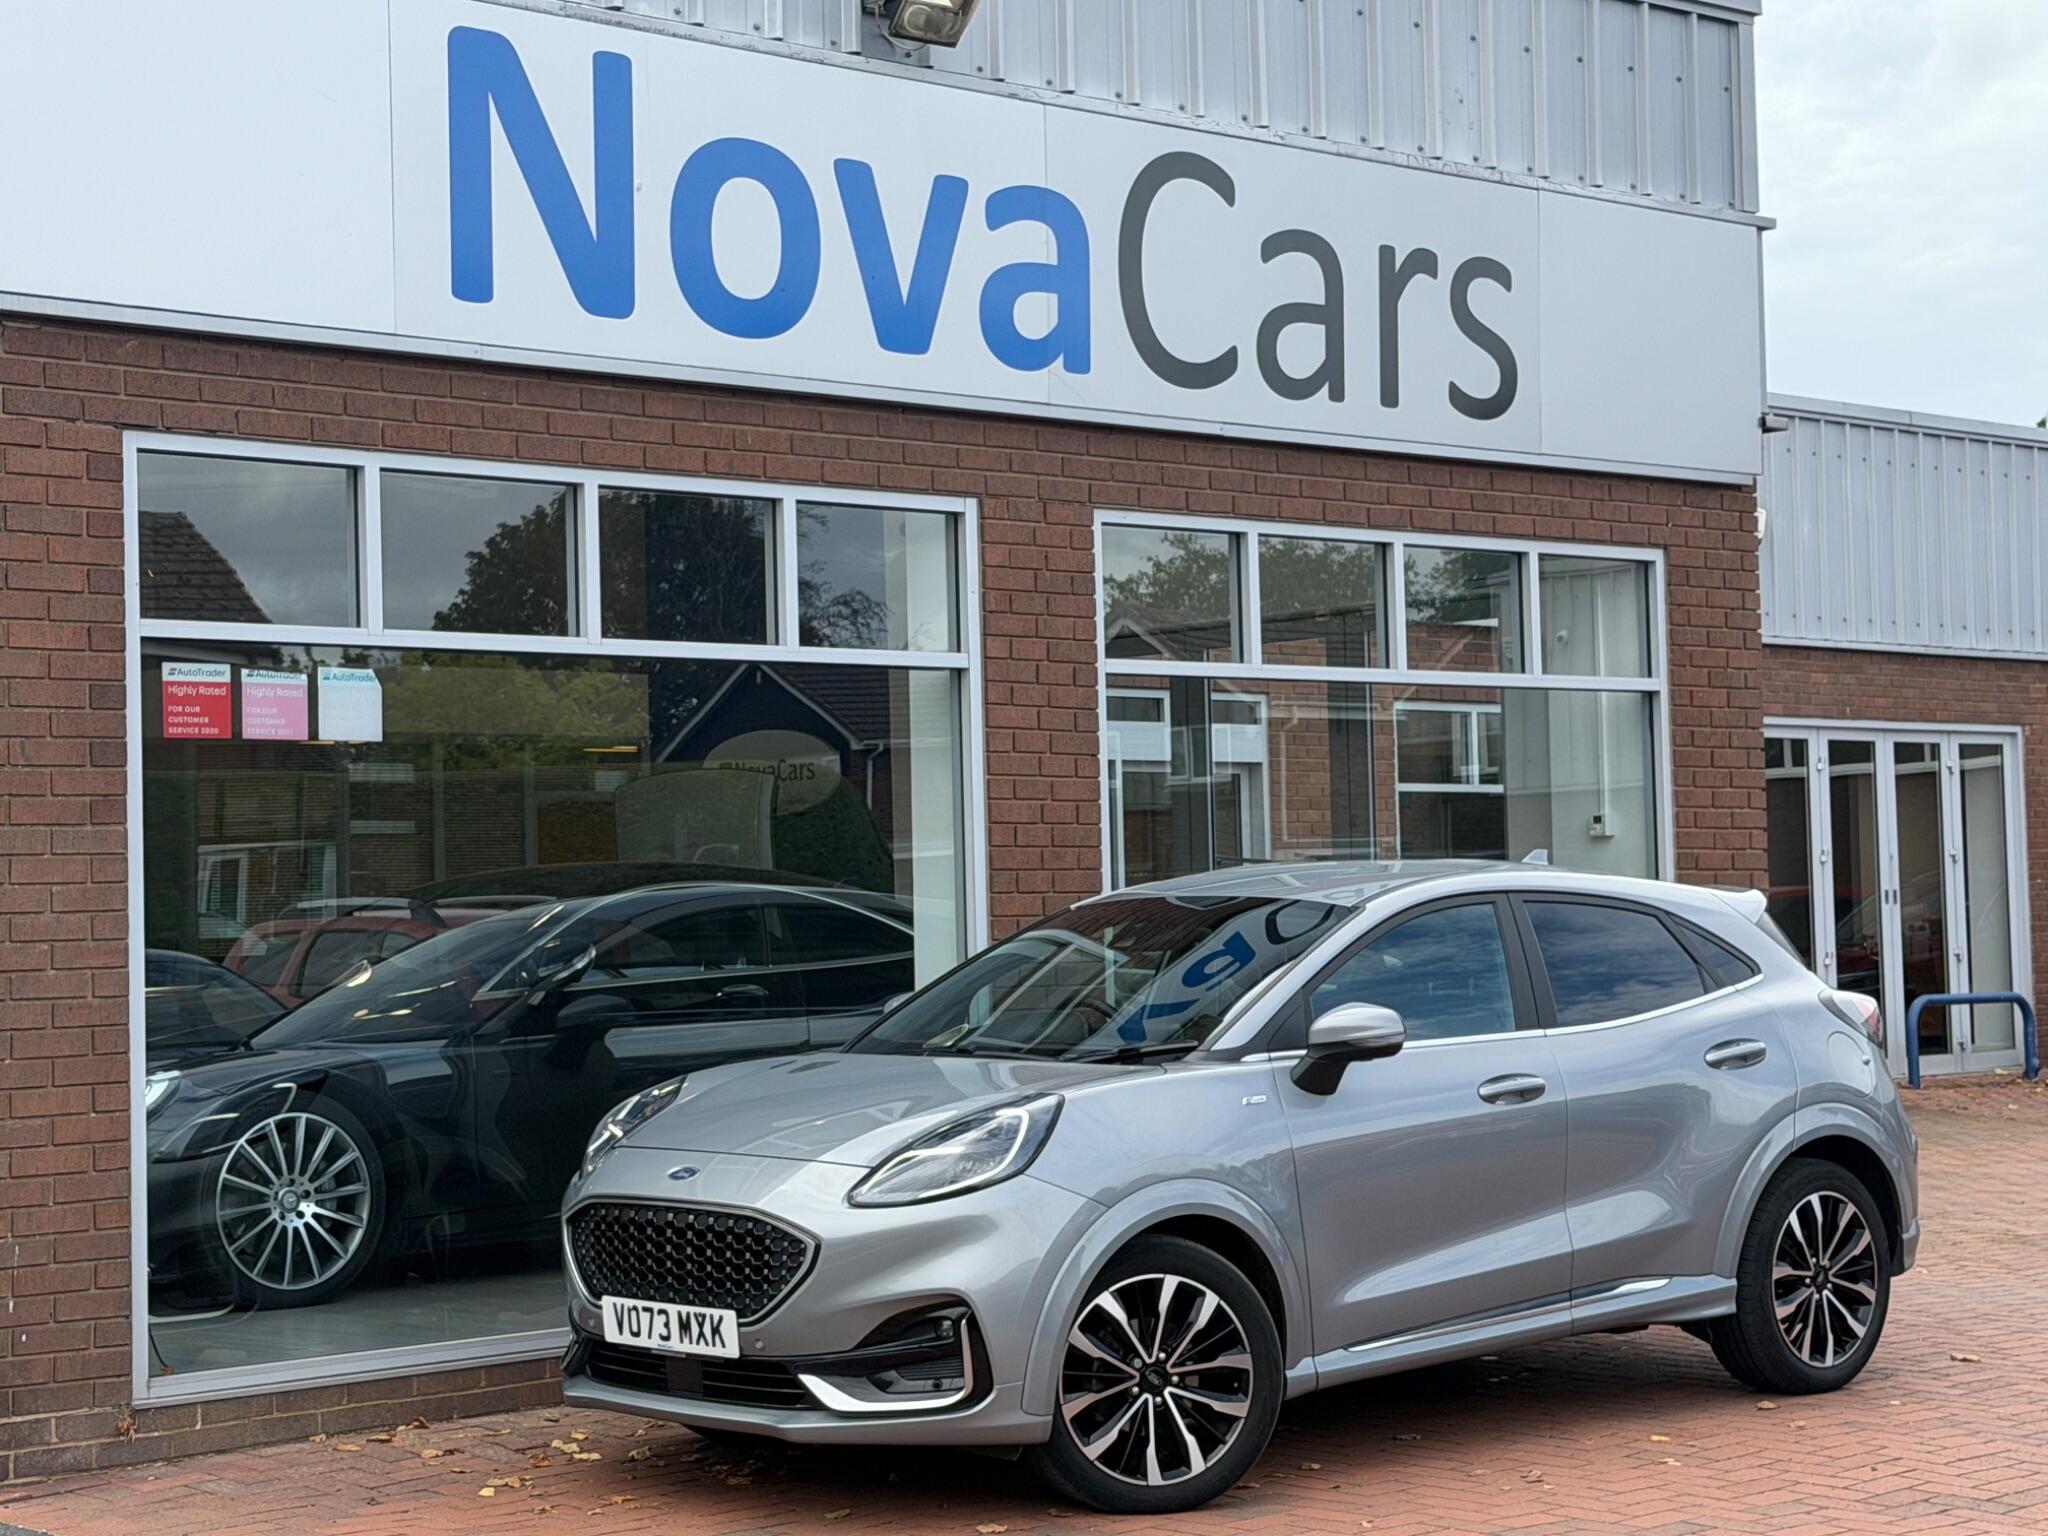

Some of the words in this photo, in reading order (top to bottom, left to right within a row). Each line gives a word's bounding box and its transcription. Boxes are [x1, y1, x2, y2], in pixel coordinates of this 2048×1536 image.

[447, 26, 1519, 420] NovaCars
[177, 668, 226, 678] AutoTrader
[331, 672, 375, 682] AutoTrade
[168, 685, 197, 696] Highly
[199, 685, 226, 696] Rated
[247, 687, 275, 698] Highly
[276, 688, 303, 697] Rated
[677, 1310, 726, 1349] MXK
